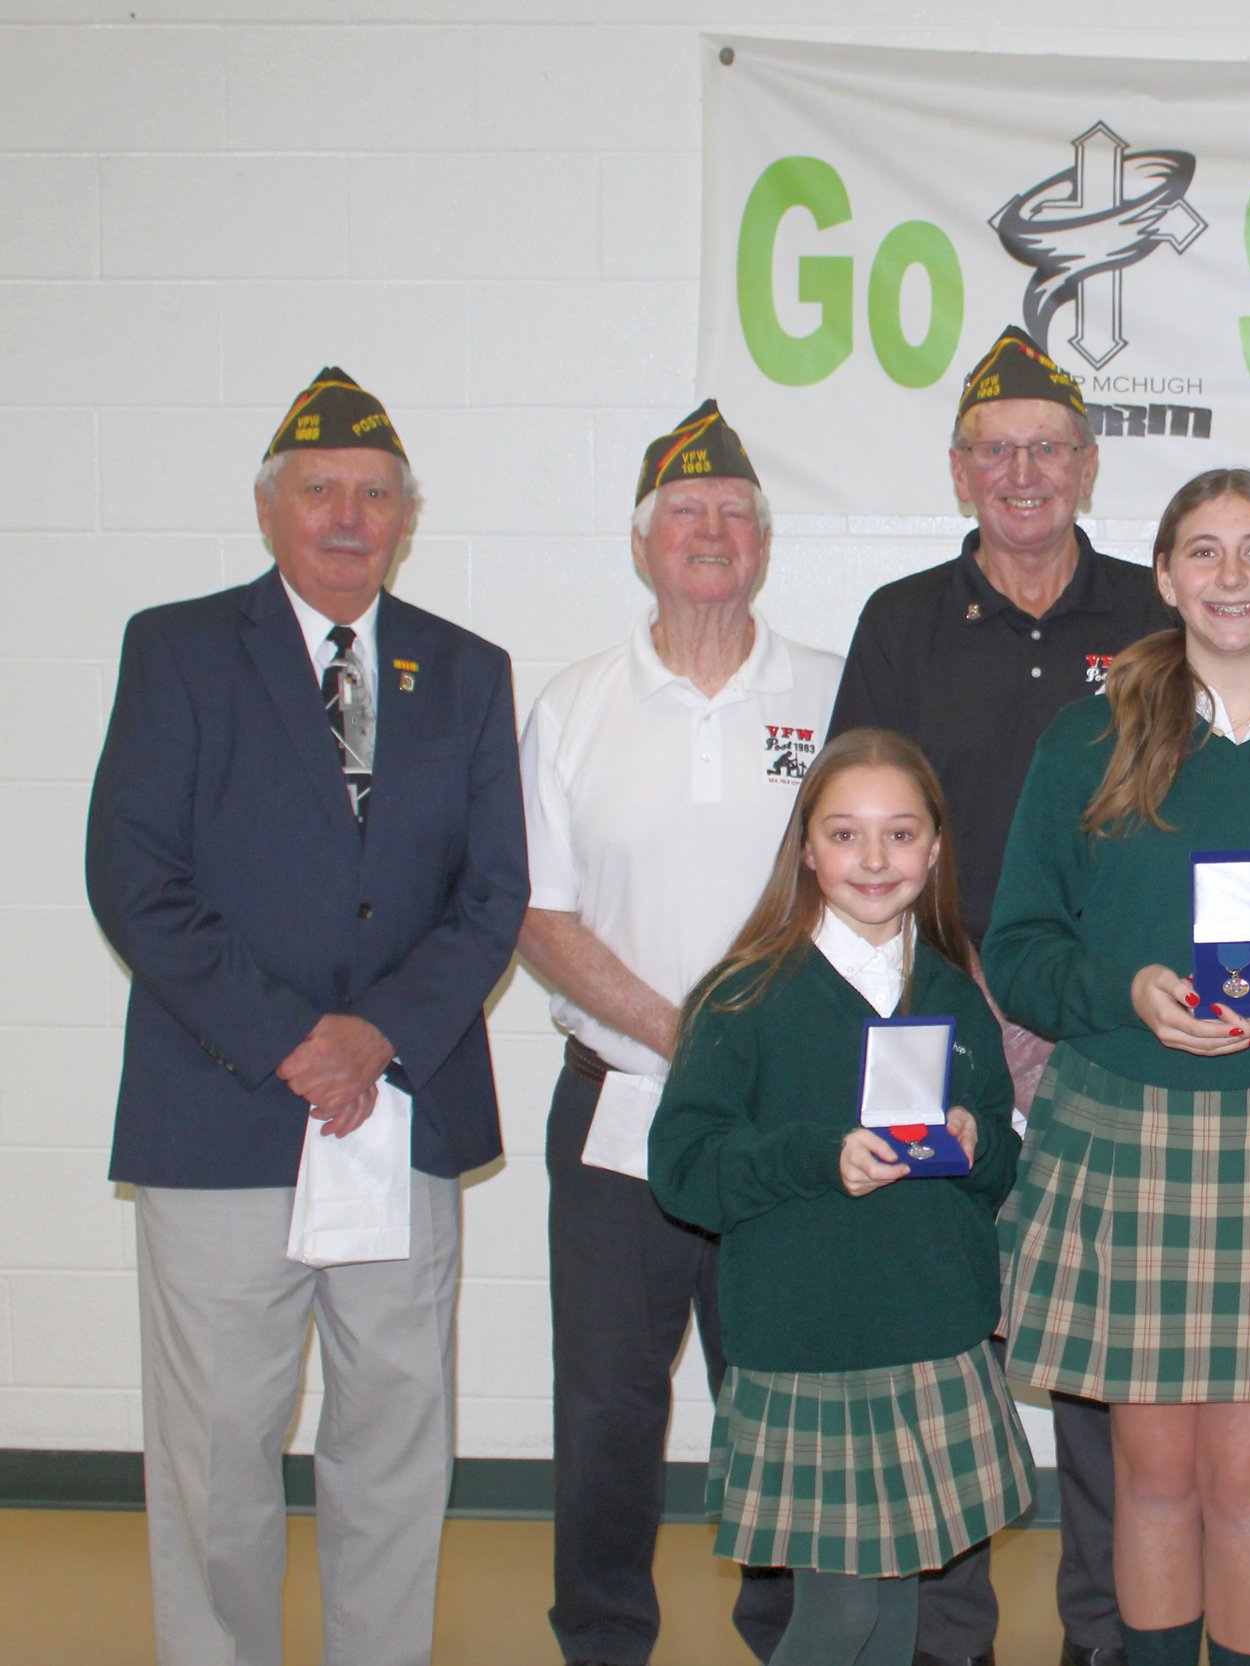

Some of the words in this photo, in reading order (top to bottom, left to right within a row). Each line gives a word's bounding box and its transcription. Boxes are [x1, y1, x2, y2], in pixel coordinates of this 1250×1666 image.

[736, 155, 965, 389] Go
[1092, 376, 1203, 394] MCHUGH
[681, 449, 706, 463] VFW
[765, 725, 814, 741] VFW
[765, 737, 792, 751] Post
